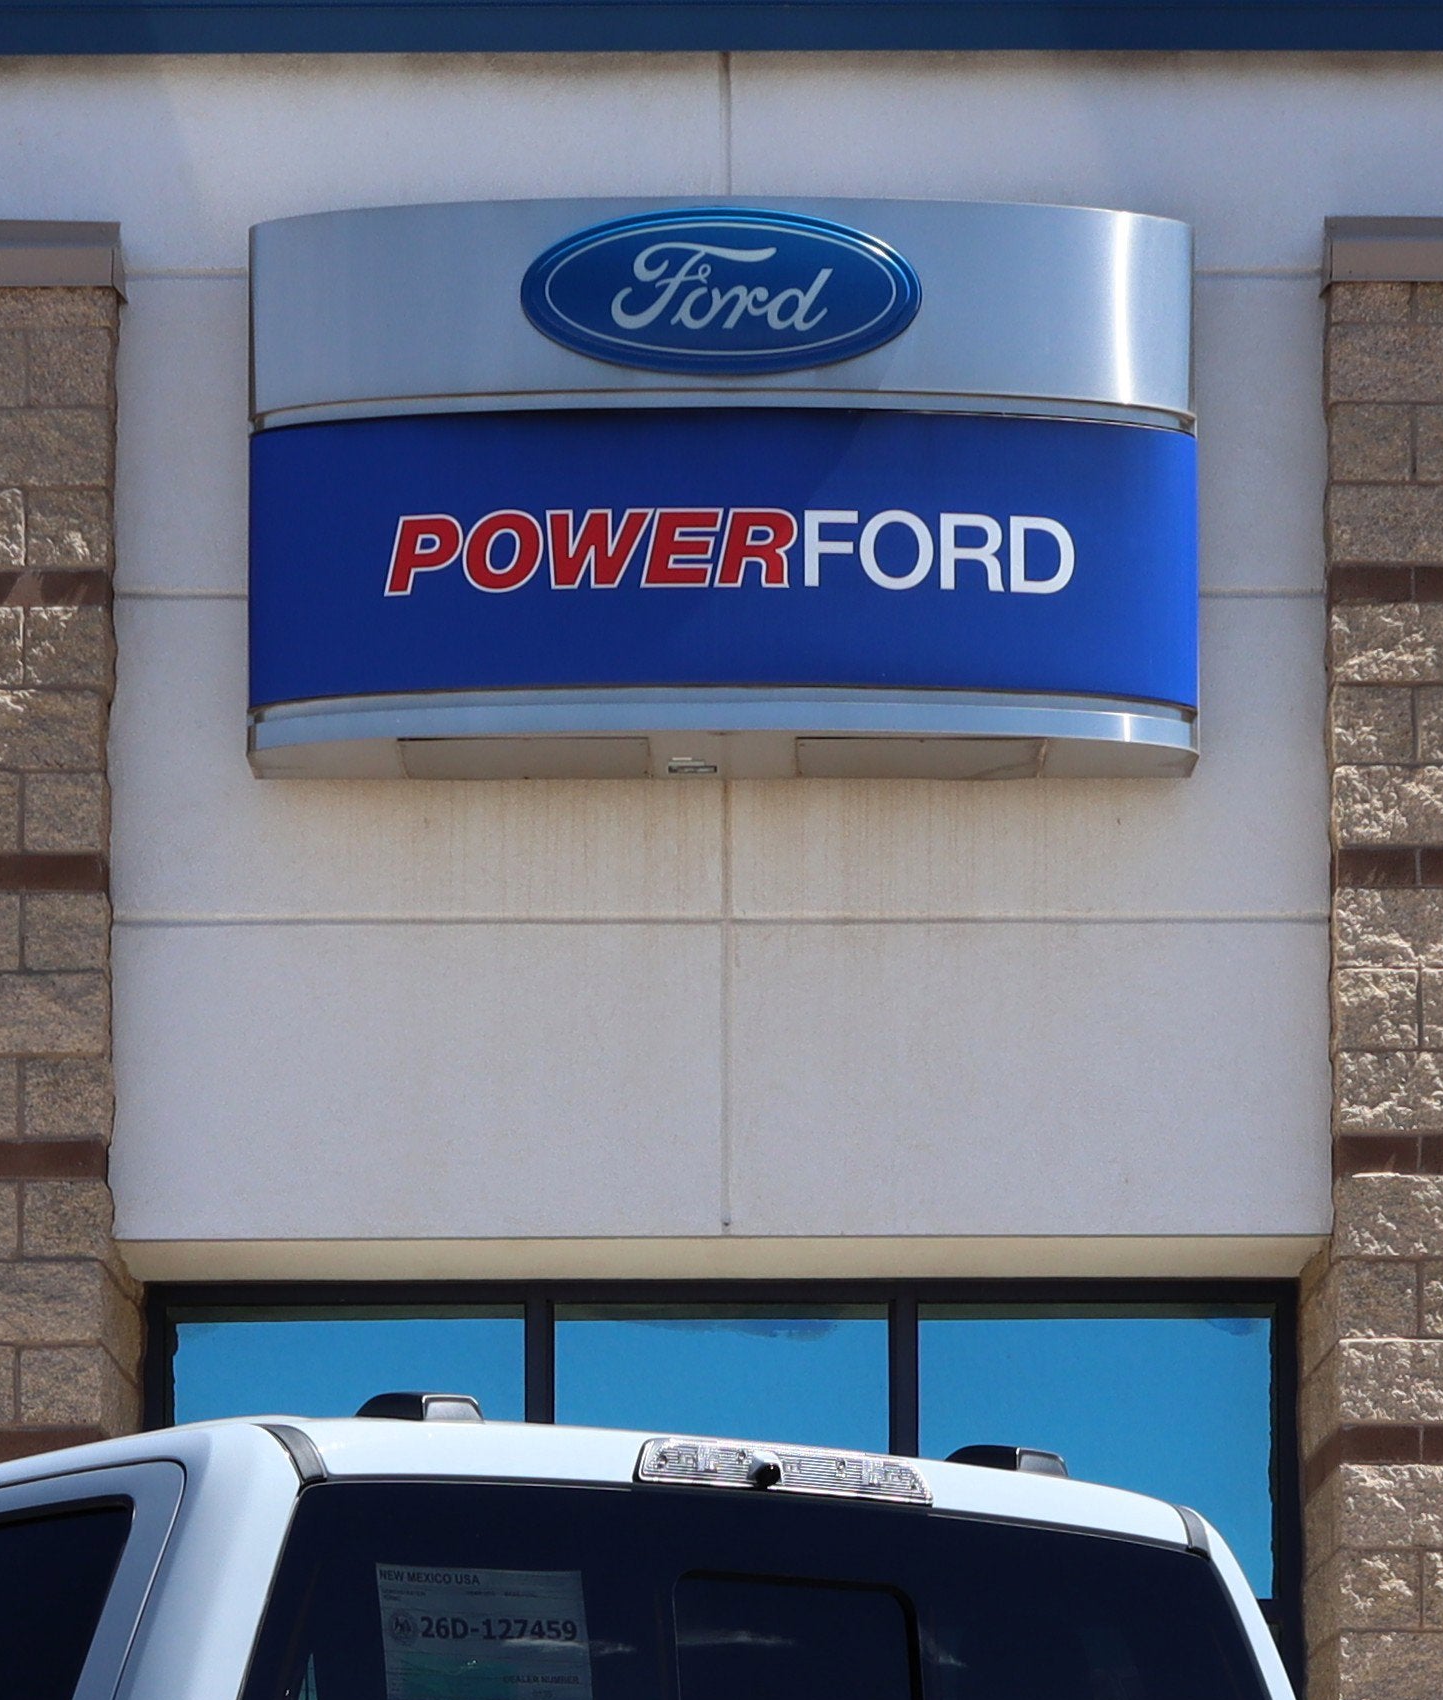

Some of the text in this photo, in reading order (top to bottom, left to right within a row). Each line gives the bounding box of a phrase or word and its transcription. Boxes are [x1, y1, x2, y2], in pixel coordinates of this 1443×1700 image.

[609, 239, 835, 333] Ford
[383, 506, 1076, 597] POWERFORD
[379, 1569, 481, 1586] NEW MEXICO USA
[420, 1615, 578, 1641] 26D-127459
